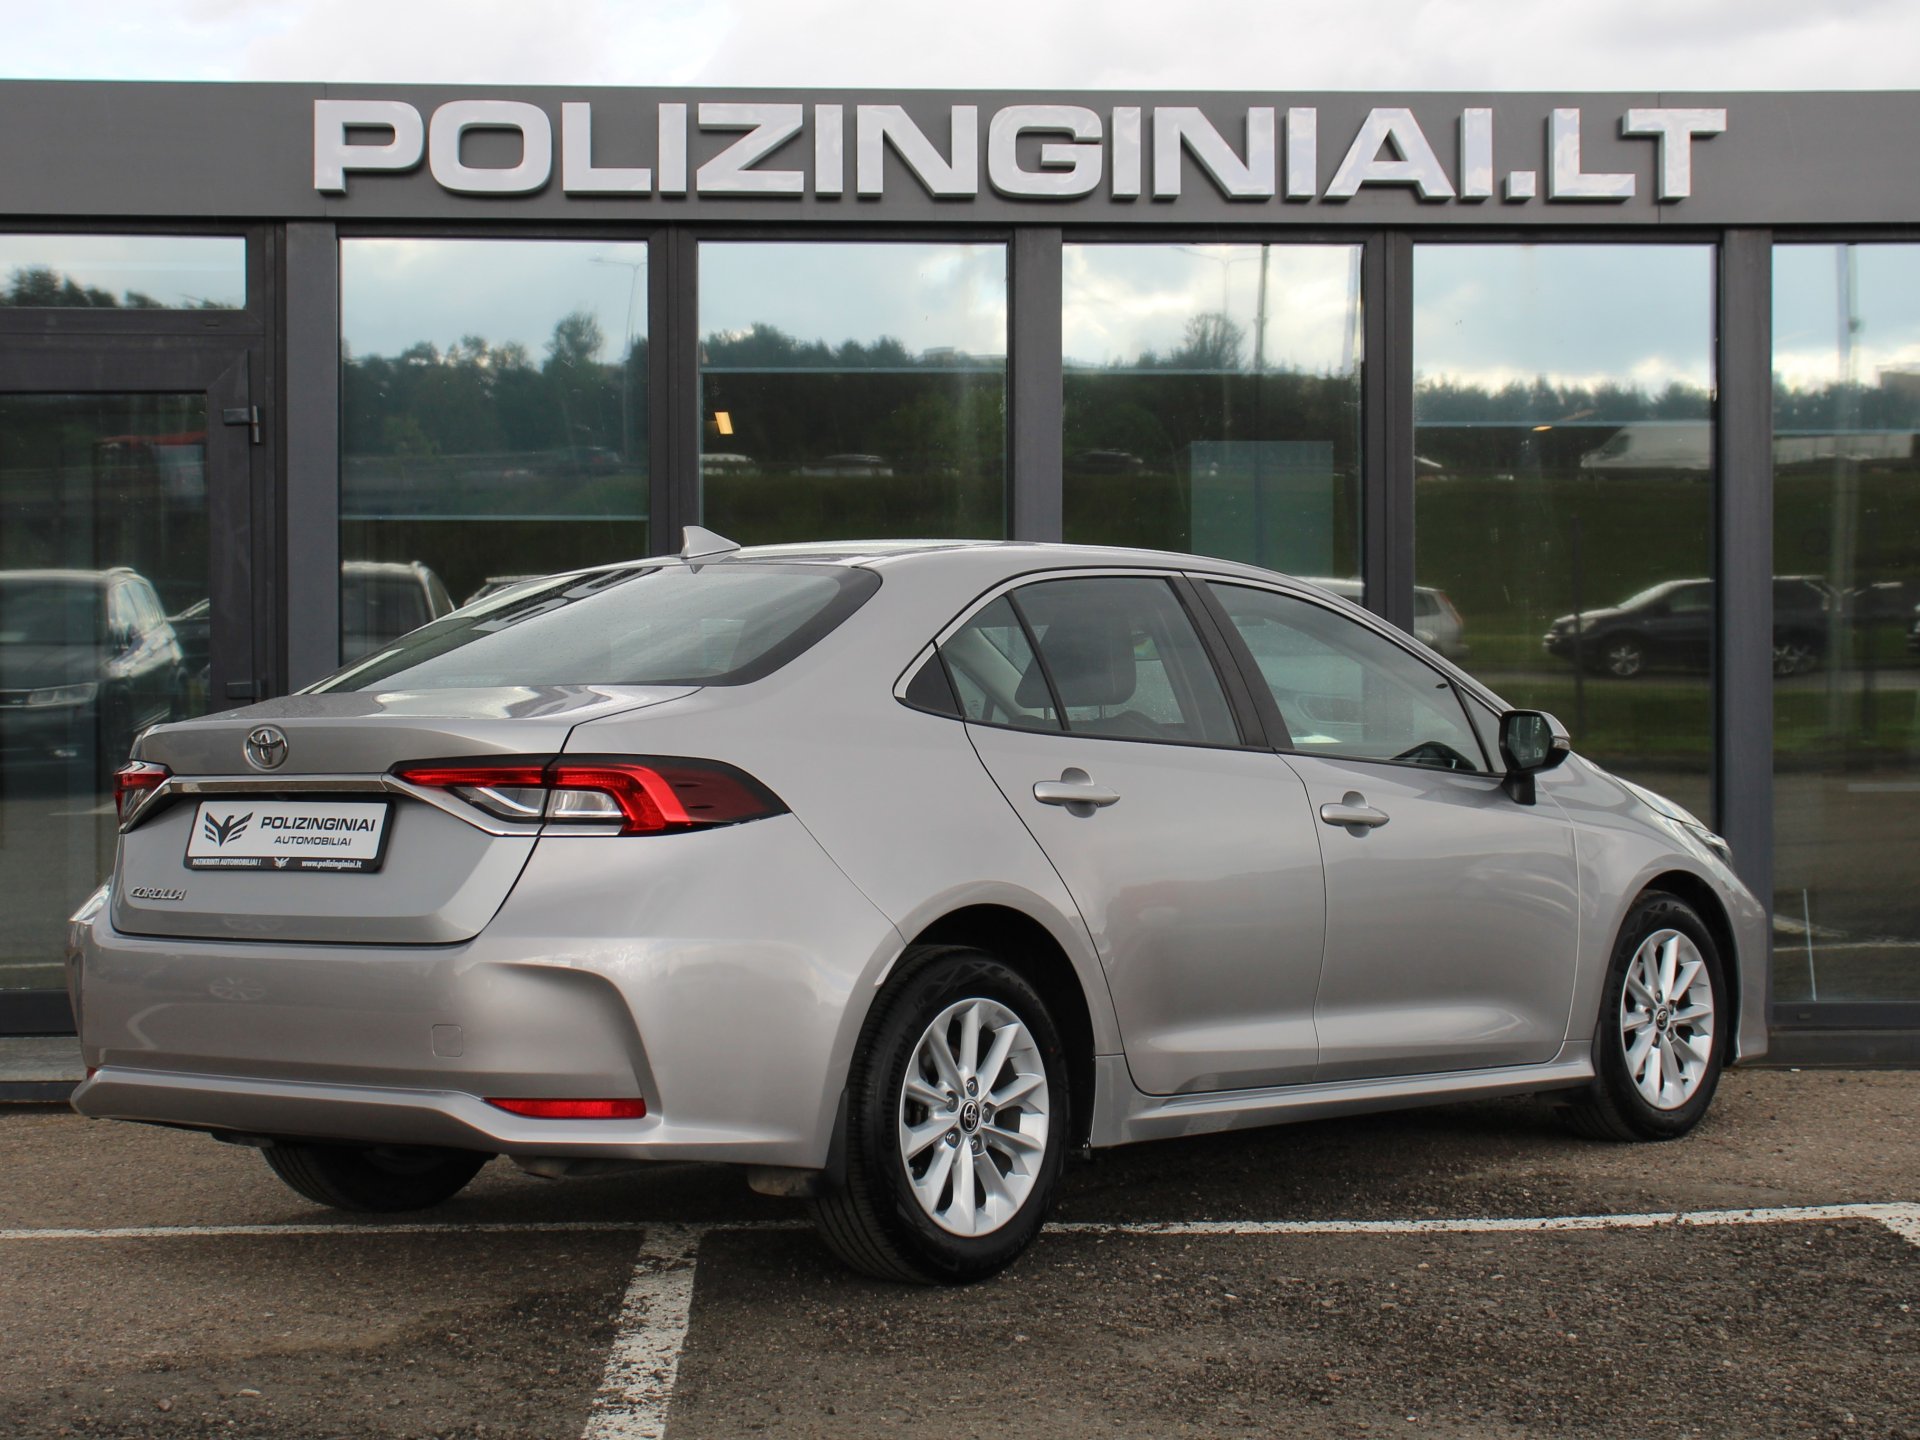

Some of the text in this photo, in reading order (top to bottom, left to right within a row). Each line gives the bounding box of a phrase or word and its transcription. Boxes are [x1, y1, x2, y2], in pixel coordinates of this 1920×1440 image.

[314, 99, 1727, 199] POLIZINGINIAI.LT
[260, 816, 376, 832] POLIZINGINIAI
[274, 835, 352, 847] AUTOMOBILIAI
[220, 858, 258, 866] AUTOMOBILIAI
[301, 860, 362, 869] www.polizinginiai.lt
[131, 886, 187, 900] COROLLA
